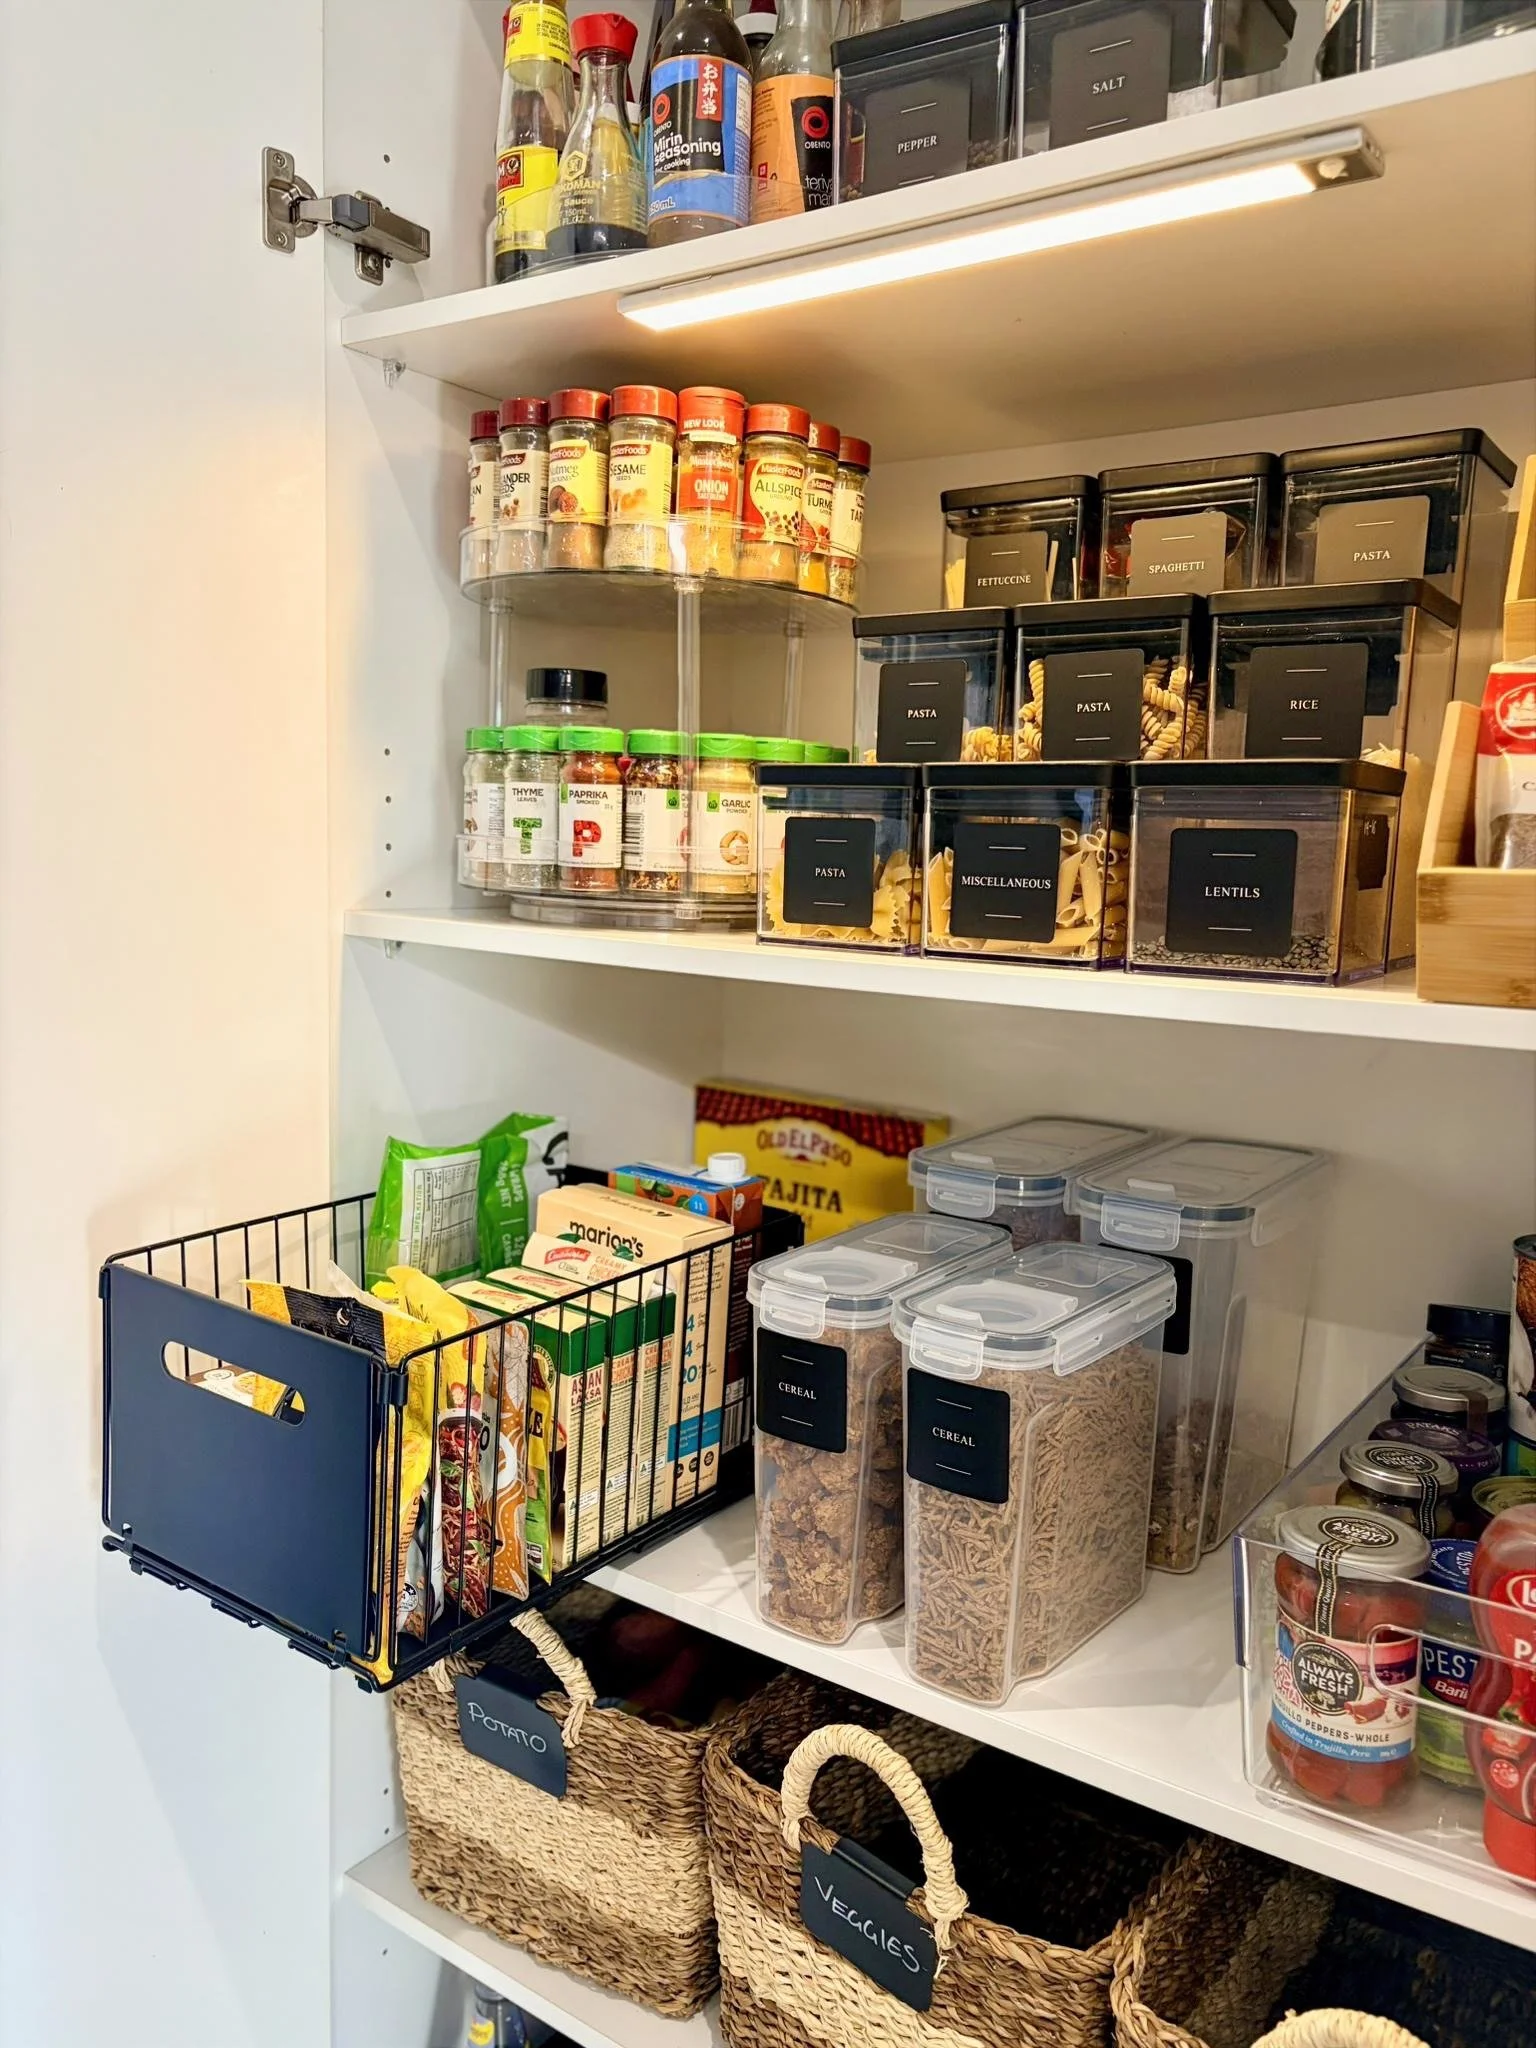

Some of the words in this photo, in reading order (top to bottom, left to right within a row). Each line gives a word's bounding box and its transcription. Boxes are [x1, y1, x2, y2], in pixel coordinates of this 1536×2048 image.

[1092, 76, 1125, 94] SALT
[654, 132, 683, 154] Mirin
[654, 137, 721, 167] seasoning
[804, 141, 831, 149] OBENTO
[897, 135, 937, 154] PEPPER
[805, 173, 833, 191] teriy
[684, 419, 701, 430] NEW
[701, 418, 725, 430] LOOK
[694, 479, 729, 497] ONION
[1353, 550, 1391, 562] PASTA
[1148, 560, 1205, 575] SPAGHETTI
[977, 574, 1032, 587] FETTUCCINE
[907, 709, 937, 718] PASTA
[1076, 702, 1111, 713] PASTA
[1290, 699, 1319, 710] RICE
[512, 787, 544, 797] THYME
[569, 790, 609, 800] PAPRIKA
[721, 799, 751, 809] GARLIC
[815, 867, 846, 878] PASTA
[961, 874, 1052, 890] MISCELLANEOUS
[1205, 885, 1260, 899] LENTILS
[756, 1129, 787, 1152] OLD
[789, 1128, 808, 1151] EL
[810, 1132, 852, 1167] PASO
[569, 1219, 644, 1258] marion's
[571, 1369, 602, 1396] ASAN
[778, 1380, 817, 1401] CEREAL
[932, 1426, 976, 1448] CEREAL
[1297, 1657, 1355, 1685] ALWAYS
[1423, 1646, 1479, 1680] PEST
[1300, 1670, 1349, 1696] FRESH
[468, 1701, 547, 1755] POTATO
[1305, 1718, 1390, 1743] PEPPERS-WHOLE
[1350, 1748, 1371, 1758] Peru
[814, 1876, 921, 1975] VEGGIES
